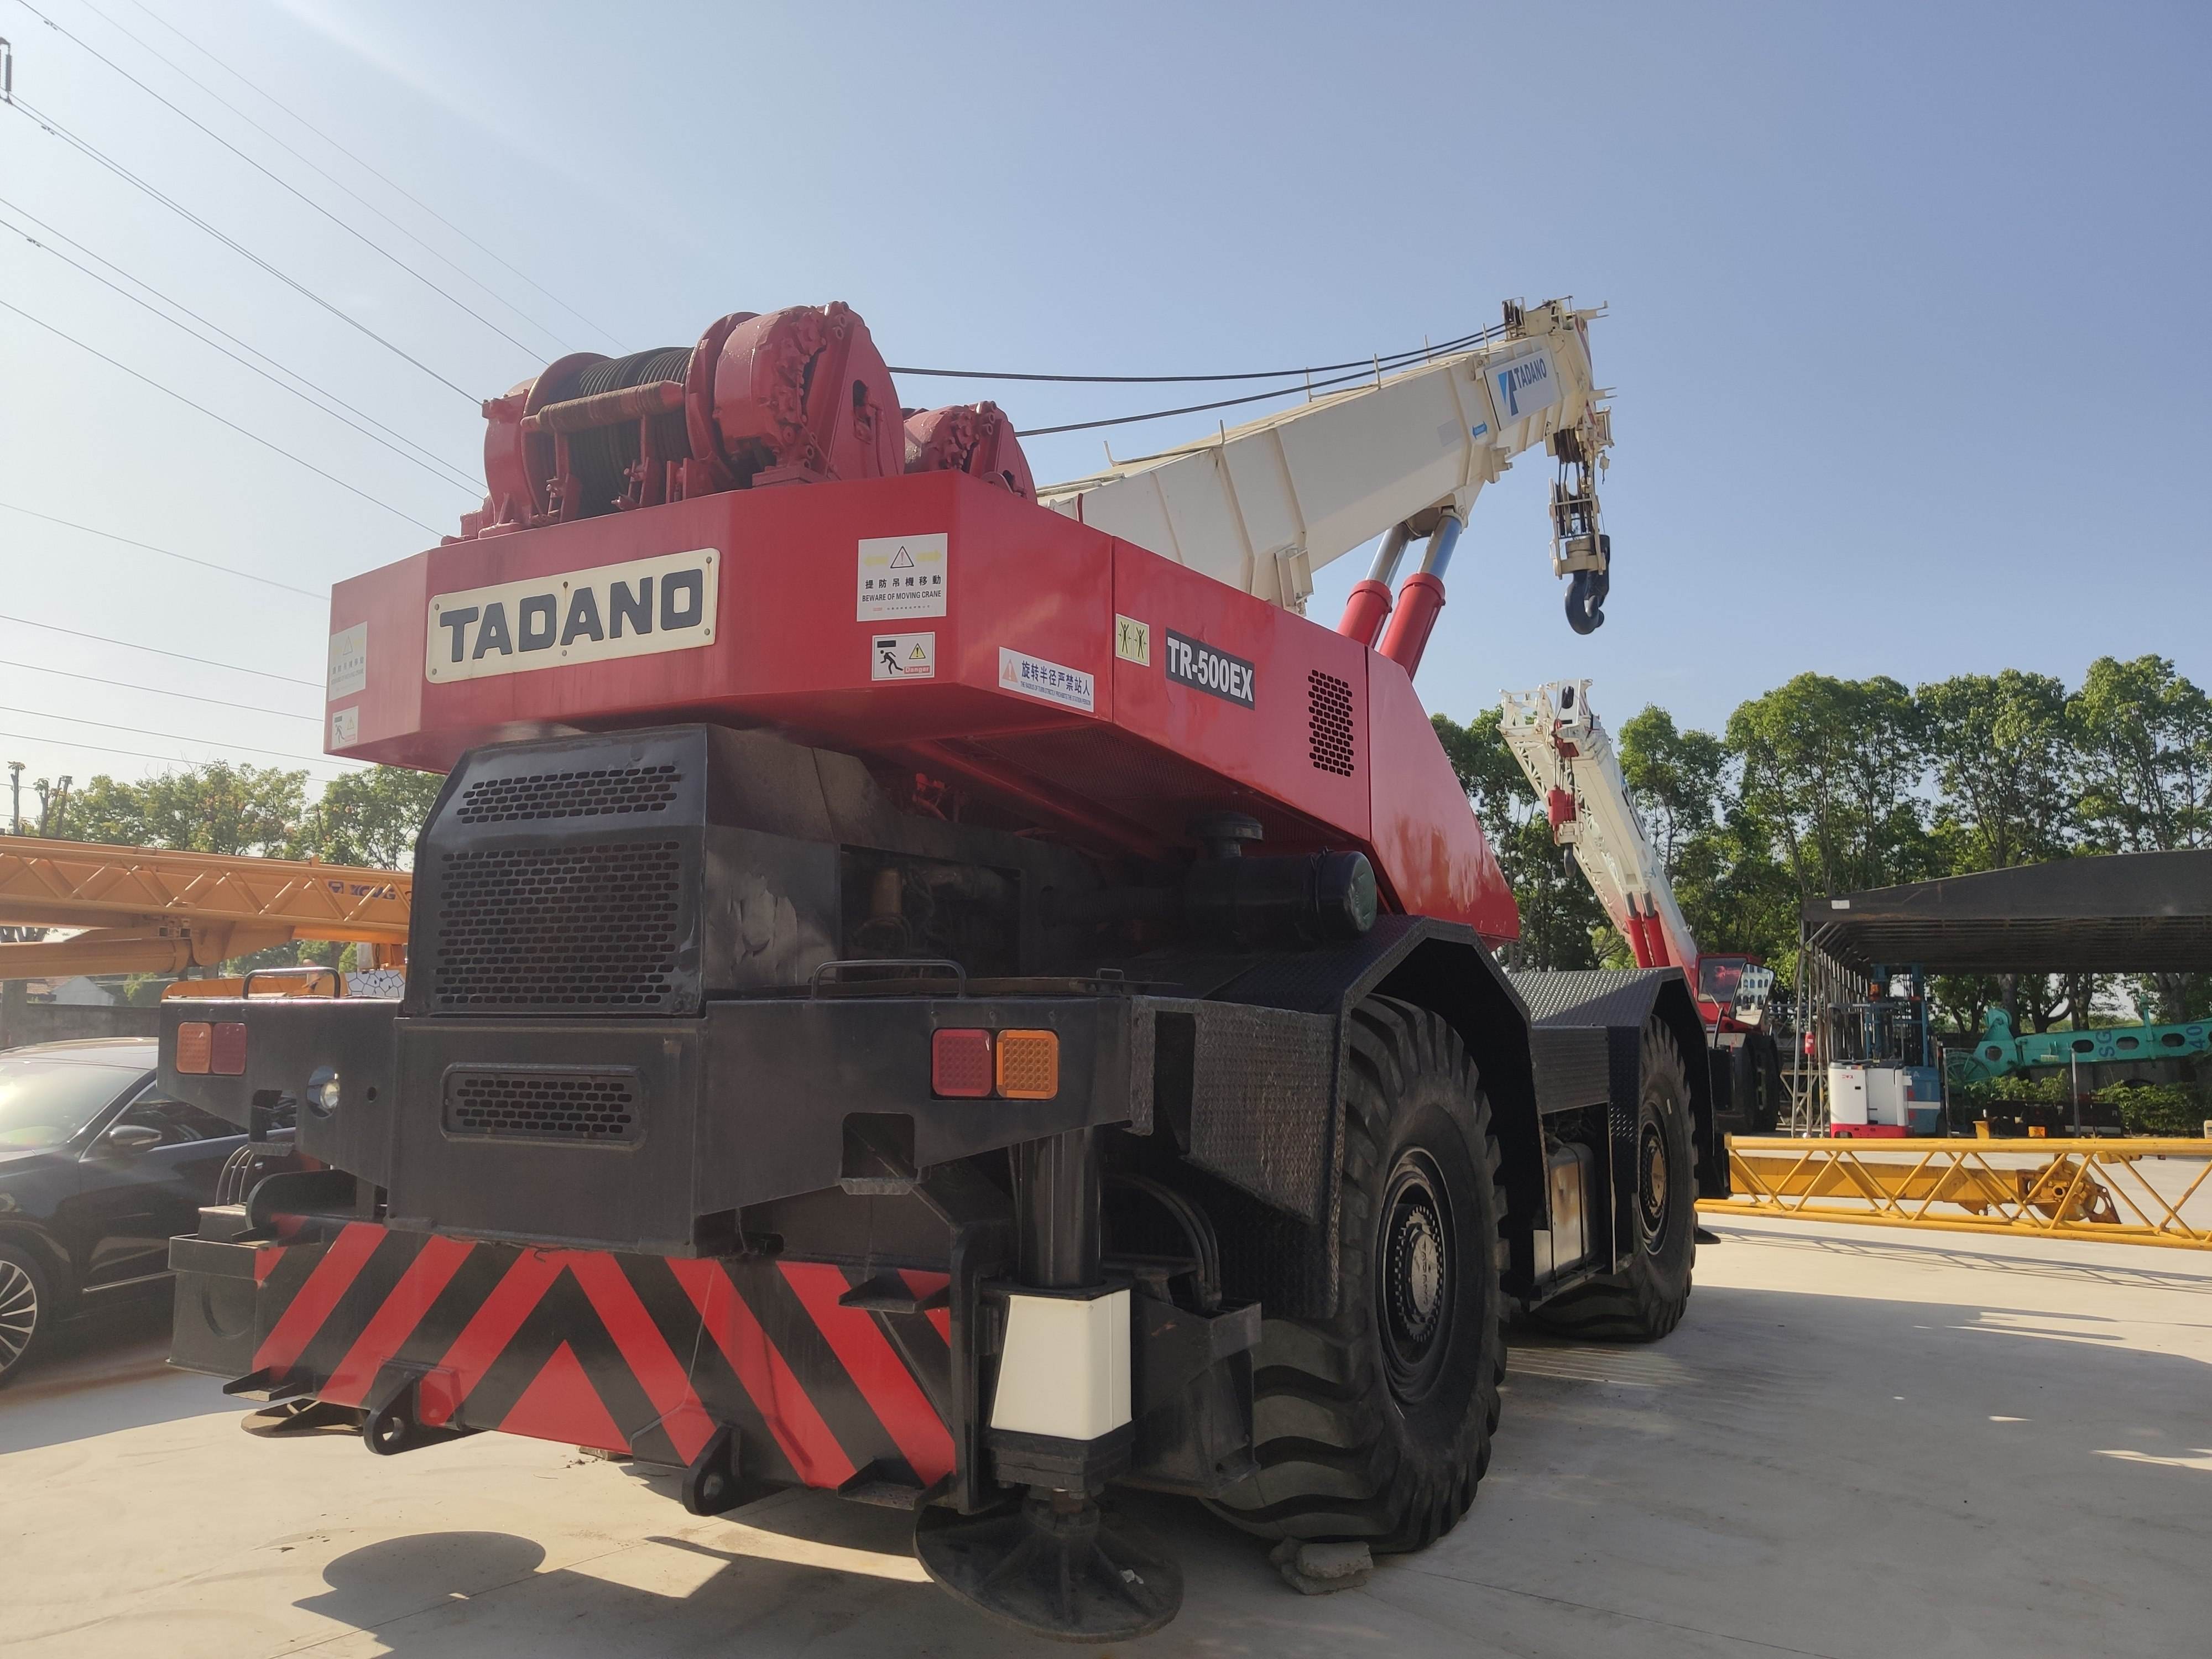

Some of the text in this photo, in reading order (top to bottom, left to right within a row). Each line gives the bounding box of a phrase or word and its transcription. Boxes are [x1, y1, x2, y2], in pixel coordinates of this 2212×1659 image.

[1513, 358, 1547, 389] TADANO
[865, 575, 941, 589] 提防吊機移動
[896, 591, 921, 600] MOVING
[440, 568, 703, 663] TADANO
[1021, 660, 1091, 696] 旋转半径严禁站人
[1167, 637, 1254, 702] TR-500EX
